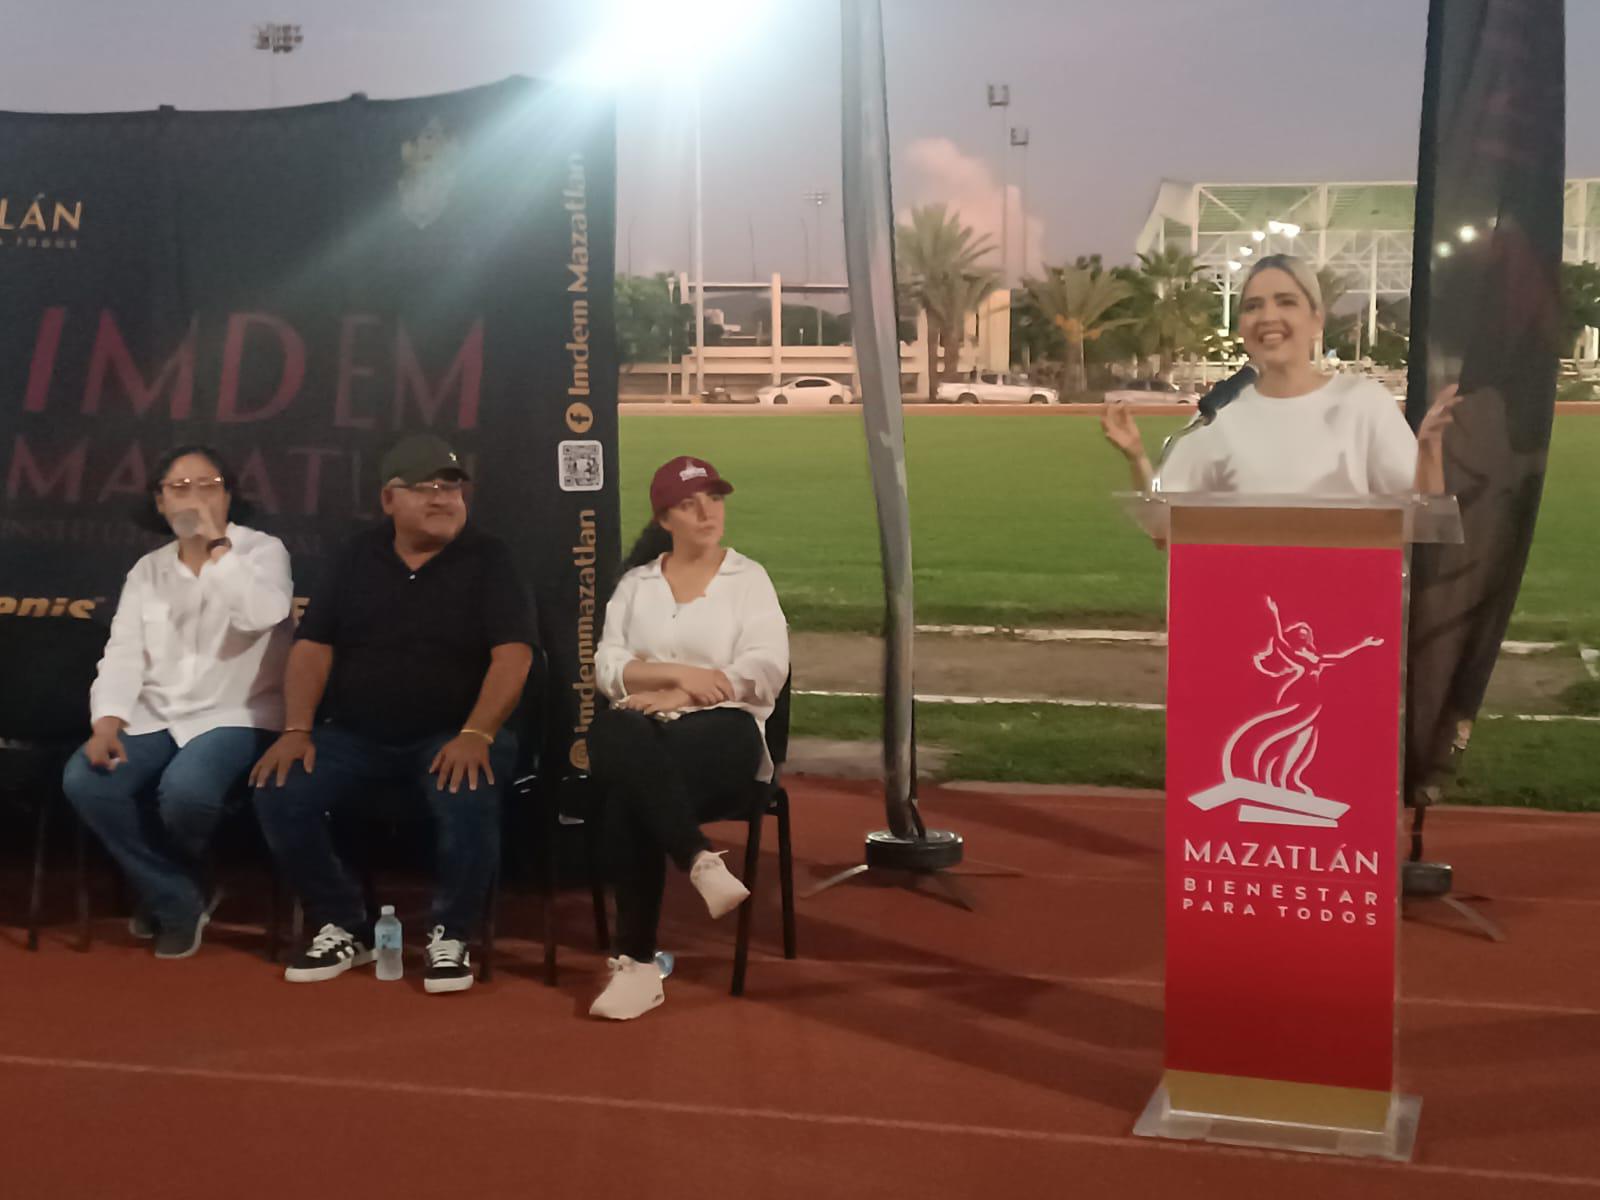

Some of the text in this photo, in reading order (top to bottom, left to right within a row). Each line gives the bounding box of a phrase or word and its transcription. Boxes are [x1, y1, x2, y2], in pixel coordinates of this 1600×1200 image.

[562, 152, 590, 395] Imdem Mazatlan
[24, 307, 486, 430] IMDEM
[1184, 839, 1379, 875] MAZATLÁN
[1184, 877, 1378, 905] BIENESTAR
[1183, 898, 1377, 926] PARA TODOS
